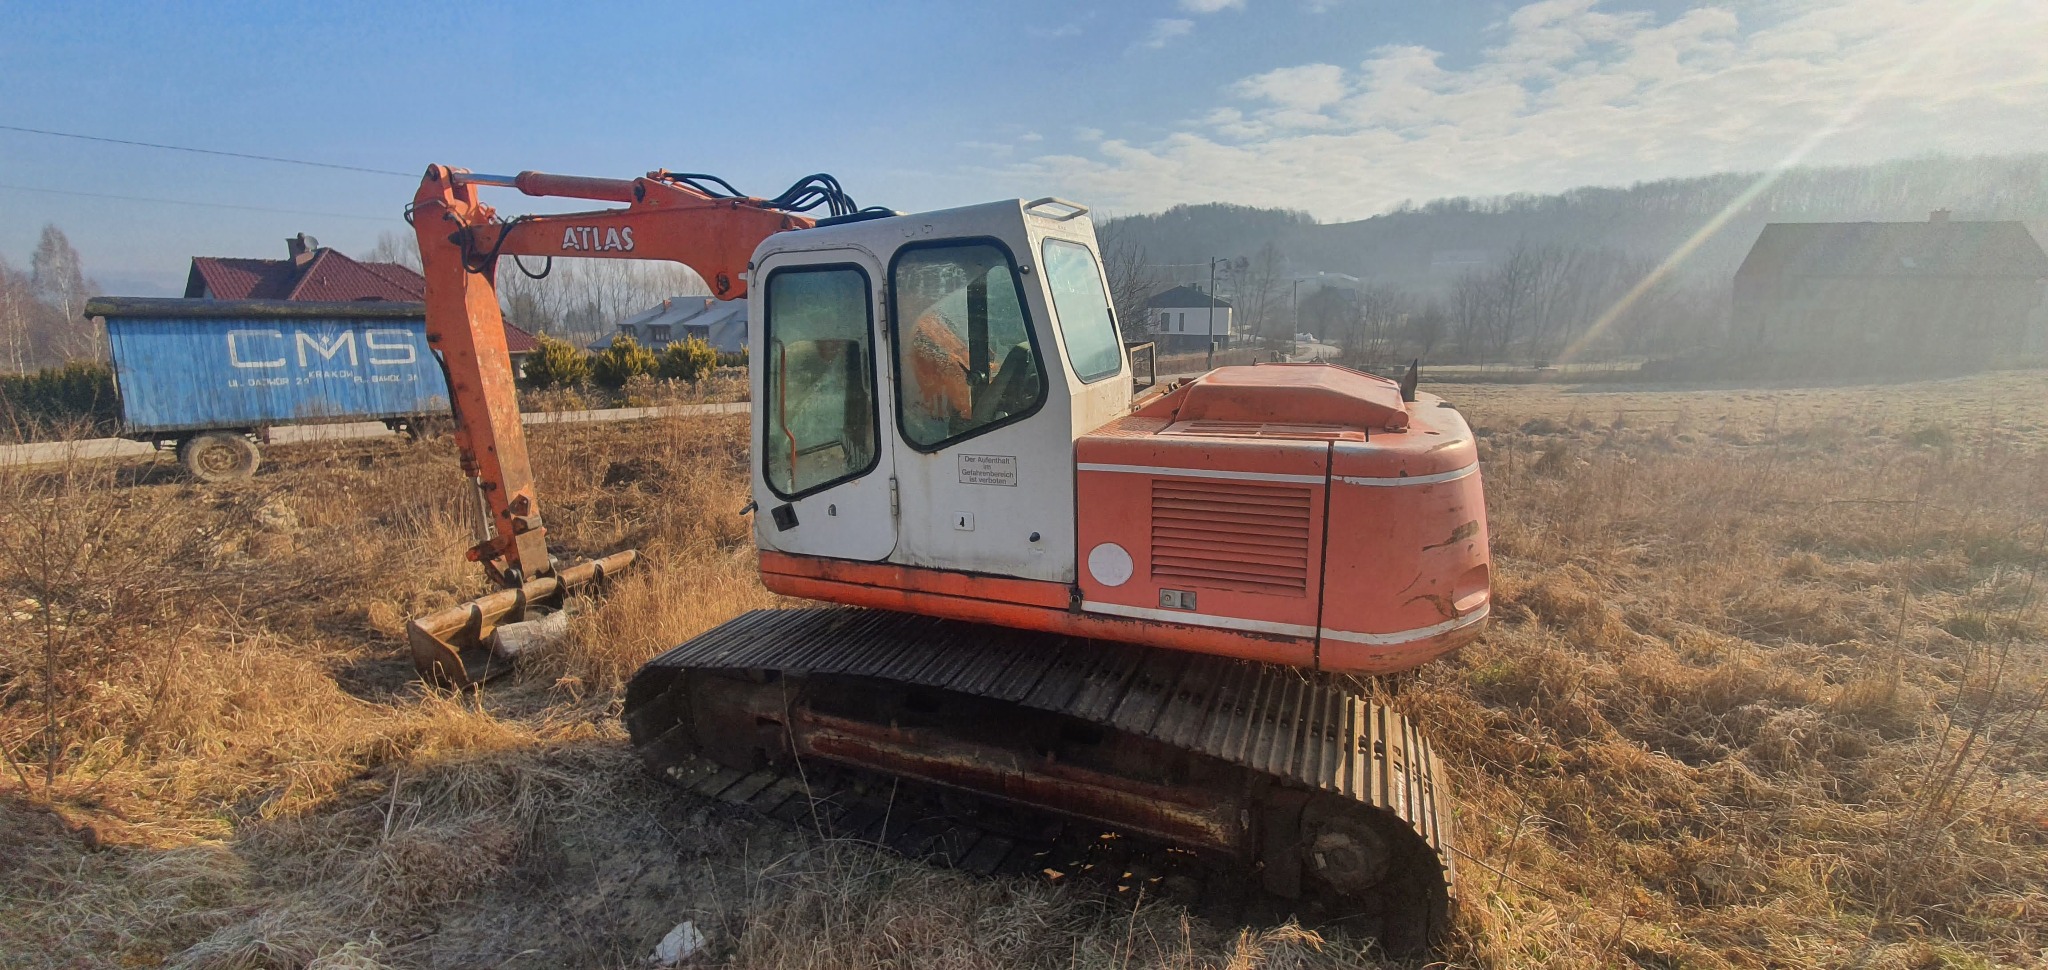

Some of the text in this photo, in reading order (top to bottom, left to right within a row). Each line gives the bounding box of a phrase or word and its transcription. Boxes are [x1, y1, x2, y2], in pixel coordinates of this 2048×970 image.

[561, 226, 635, 251] ATLAS
[227, 328, 417, 368] CMS
[962, 468, 1014, 478] Gefahrenbereich
